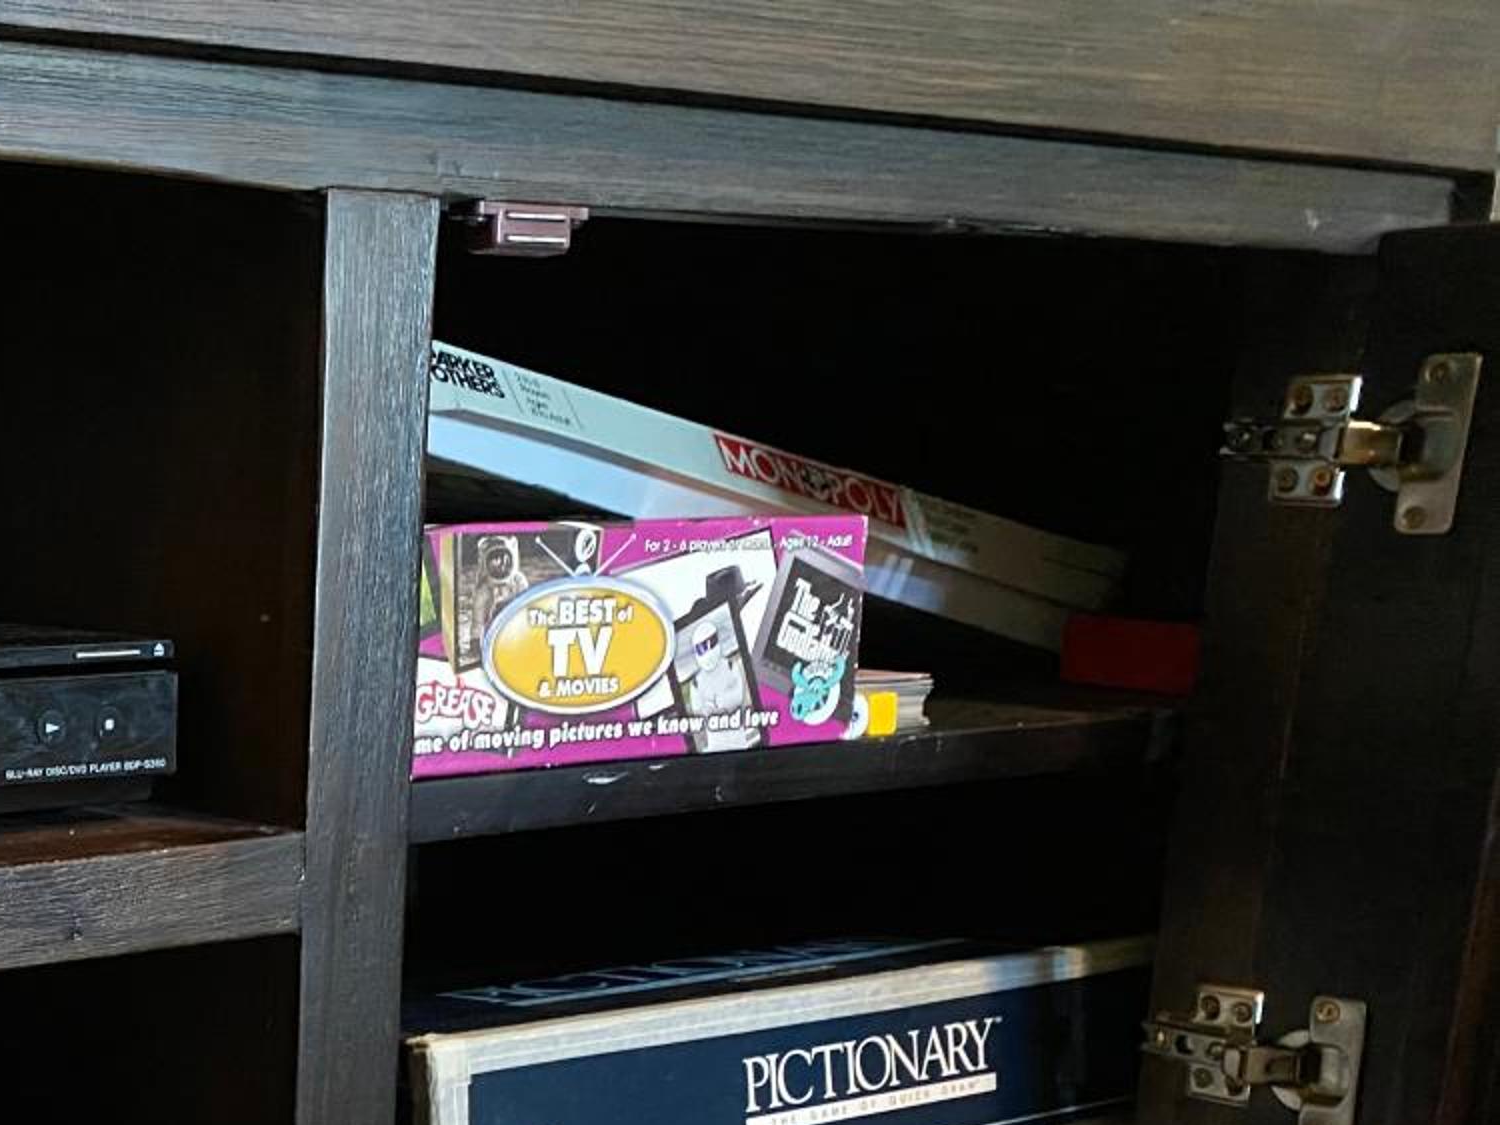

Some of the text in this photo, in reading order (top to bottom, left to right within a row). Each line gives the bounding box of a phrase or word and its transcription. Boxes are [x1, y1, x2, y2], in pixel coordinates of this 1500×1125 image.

[431, 365, 505, 398] OTHERS
[719, 438, 901, 526] MONOPOLY
[645, 539, 661, 551] For
[529, 597, 634, 625] The BEST of
[794, 577, 821, 621] The
[548, 625, 614, 680] TV
[416, 681, 497, 730] GREASE
[539, 677, 619, 698] & MOVIES
[414, 709, 780, 755] me of moving pictures we know and love
[89, 761, 122, 774] PLAYER
[742, 1017, 994, 1113] PICTIONARY
